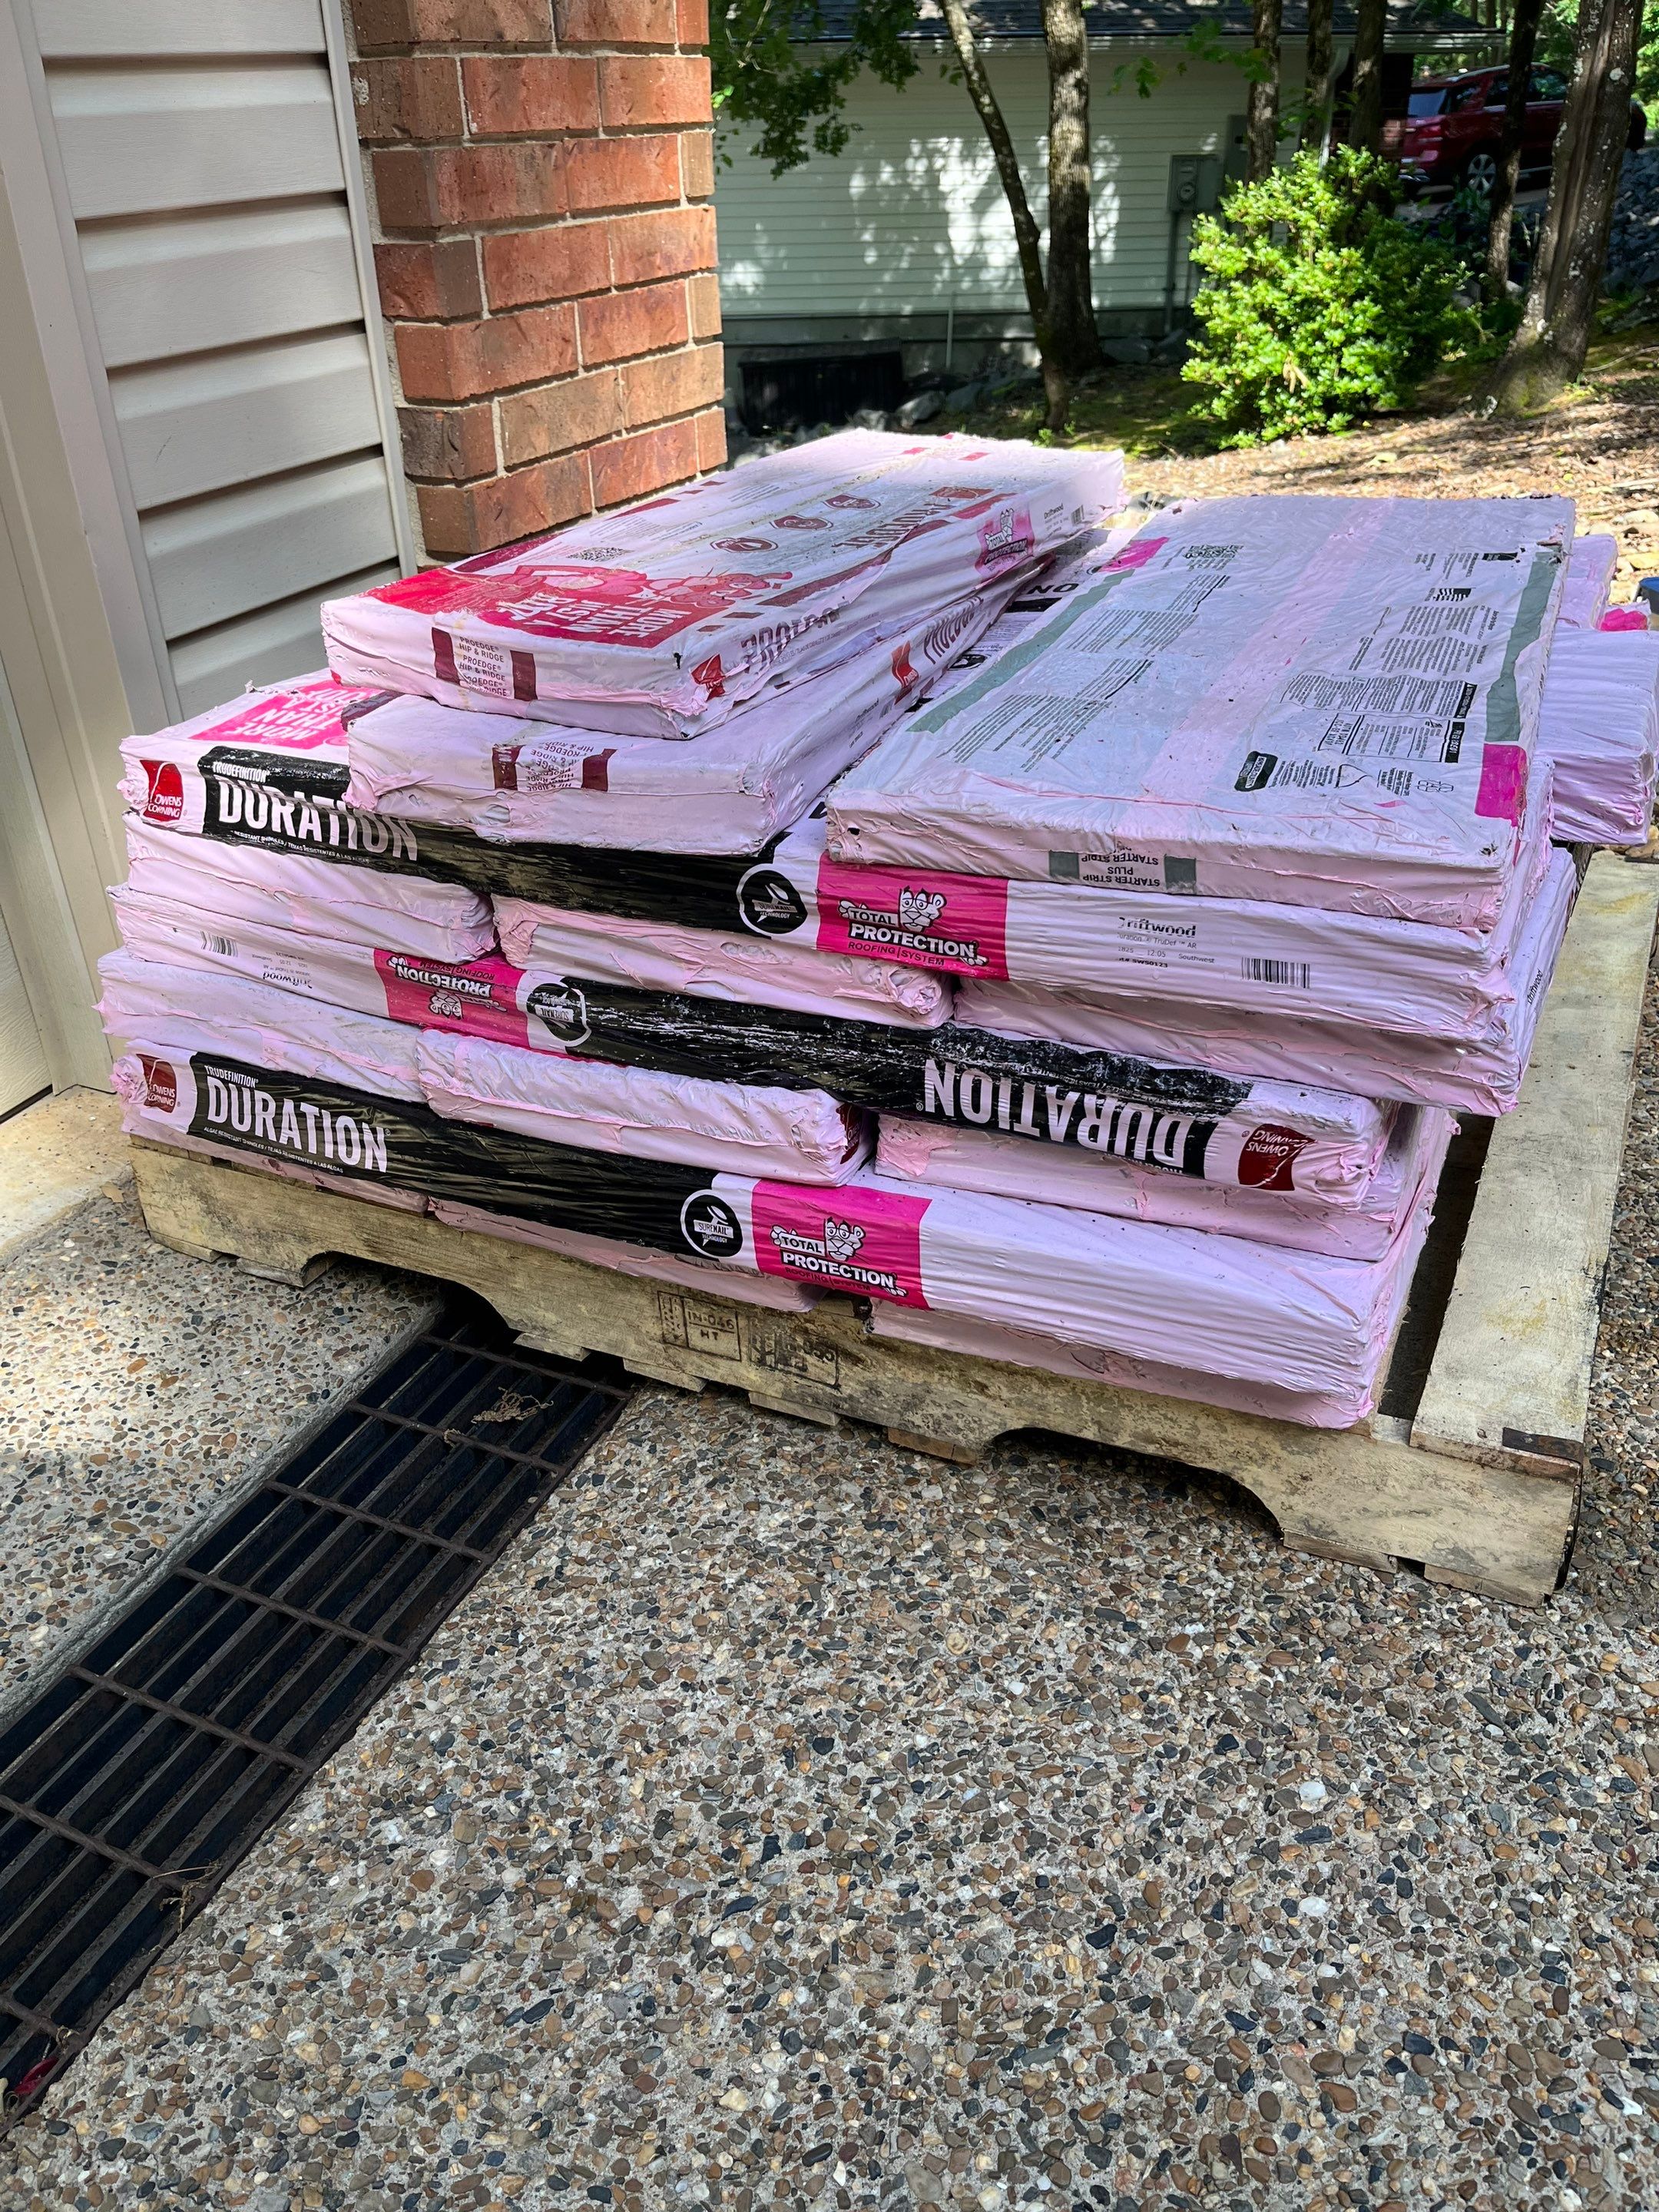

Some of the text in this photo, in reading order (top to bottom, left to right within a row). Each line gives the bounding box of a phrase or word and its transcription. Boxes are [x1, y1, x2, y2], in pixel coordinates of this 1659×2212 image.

[989, 535, 1005, 547] TOTAL
[561, 605, 653, 634] THAN
[608, 608, 691, 637] MORE
[459, 643, 472, 652] HIP
[482, 651, 504, 663] RIDGE
[459, 662, 472, 671] HIP
[482, 669, 505, 682] RIDGE
[463, 654, 498, 673] PROEDGE
[251, 708, 339, 730] THAN
[230, 721, 320, 740] MORE
[212, 760, 267, 783] TRUDEFINITION
[154, 794, 182, 807] OWENS
[147, 803, 180, 817] CORNING
[213, 775, 417, 861] DURATION
[1113, 853, 1159, 865] STARTER
[1108, 866, 1133, 875] PLUS
[1082, 874, 1161, 886] STARTER STRIP
[850, 909, 896, 926] TOTAL
[850, 923, 975, 958] PROTECTION
[848, 941, 945, 966] ROOFING SYSTEM
[1178, 953, 1215, 963] Southwest
[397, 965, 492, 998] PROTECTION
[456, 967, 495, 980] ROOFING
[204, 1065, 259, 1088] TRUDEFINITION
[147, 1093, 175, 1107] CORNING
[152, 1085, 176, 1098] OWENS
[924, 1058, 1192, 1168] DURATION
[204, 1127, 218, 1135] ALGAE
[207, 1076, 388, 1173] DURATION
[1246, 1141, 1290, 1157] OWENS
[698, 1222, 727, 1236] SURENAIL
[780, 1236, 822, 1253] TOTAL
[783, 1251, 894, 1289] PROTECTION
[785, 1267, 828, 1283] ROOFING
